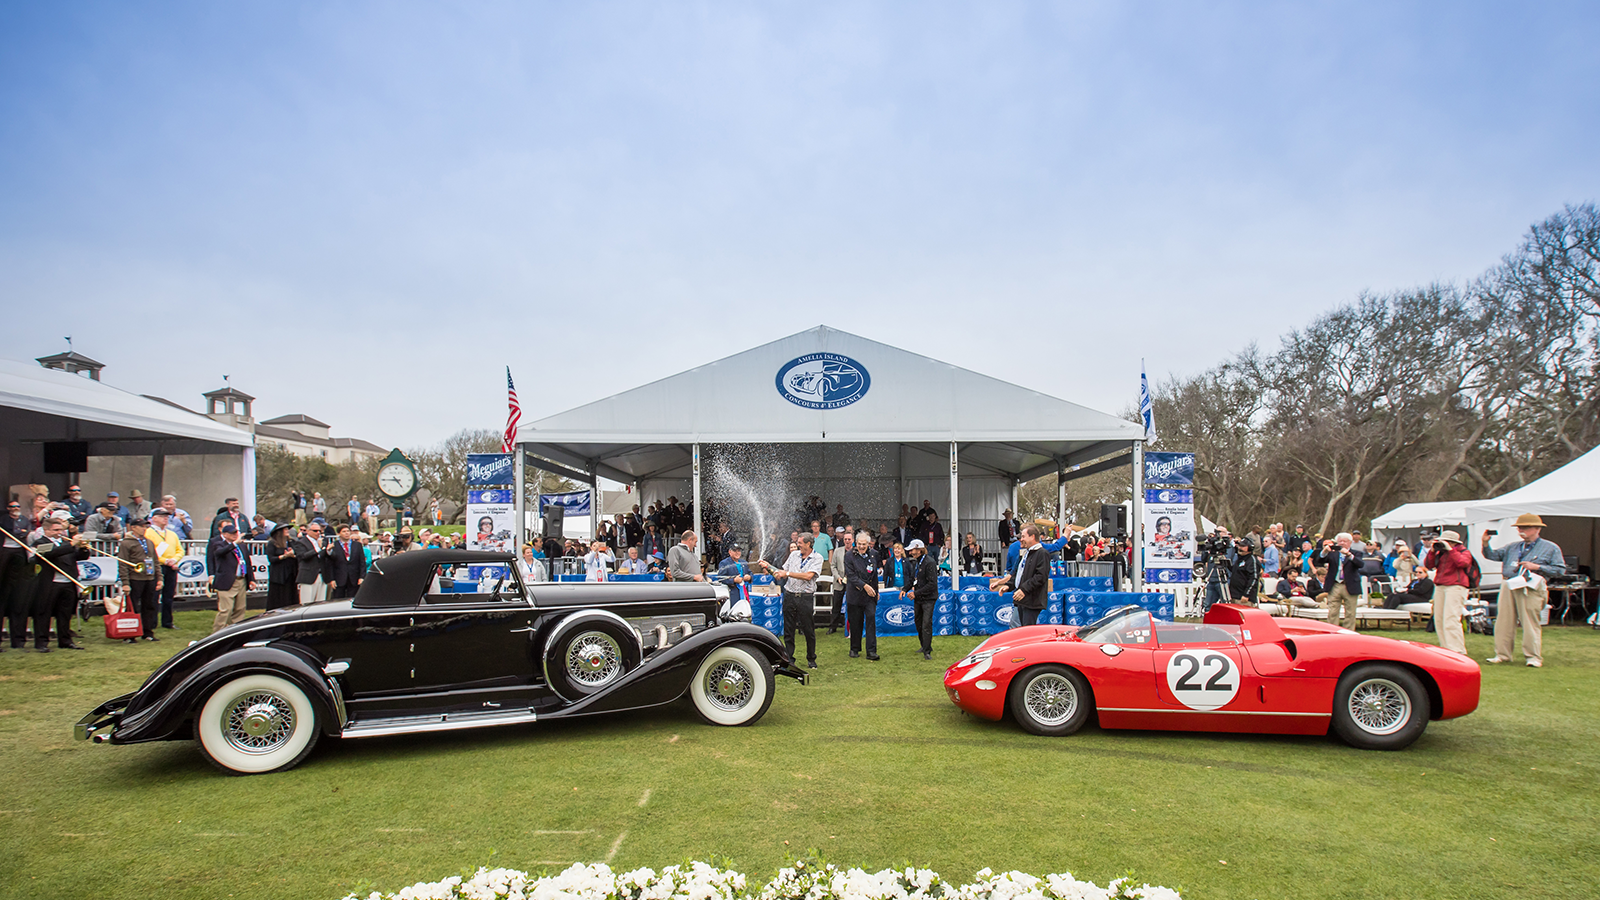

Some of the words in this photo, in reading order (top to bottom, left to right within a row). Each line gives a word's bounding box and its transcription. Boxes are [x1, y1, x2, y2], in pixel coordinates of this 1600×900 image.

[798, 355, 823, 364] AMELIA
[824, 354, 848, 363] ISLAND
[784, 392, 820, 409] CONCOURS
[468, 456, 511, 481] Meguiar's
[1146, 454, 1192, 479] Meguiar's
[1174, 654, 1232, 691] 22
